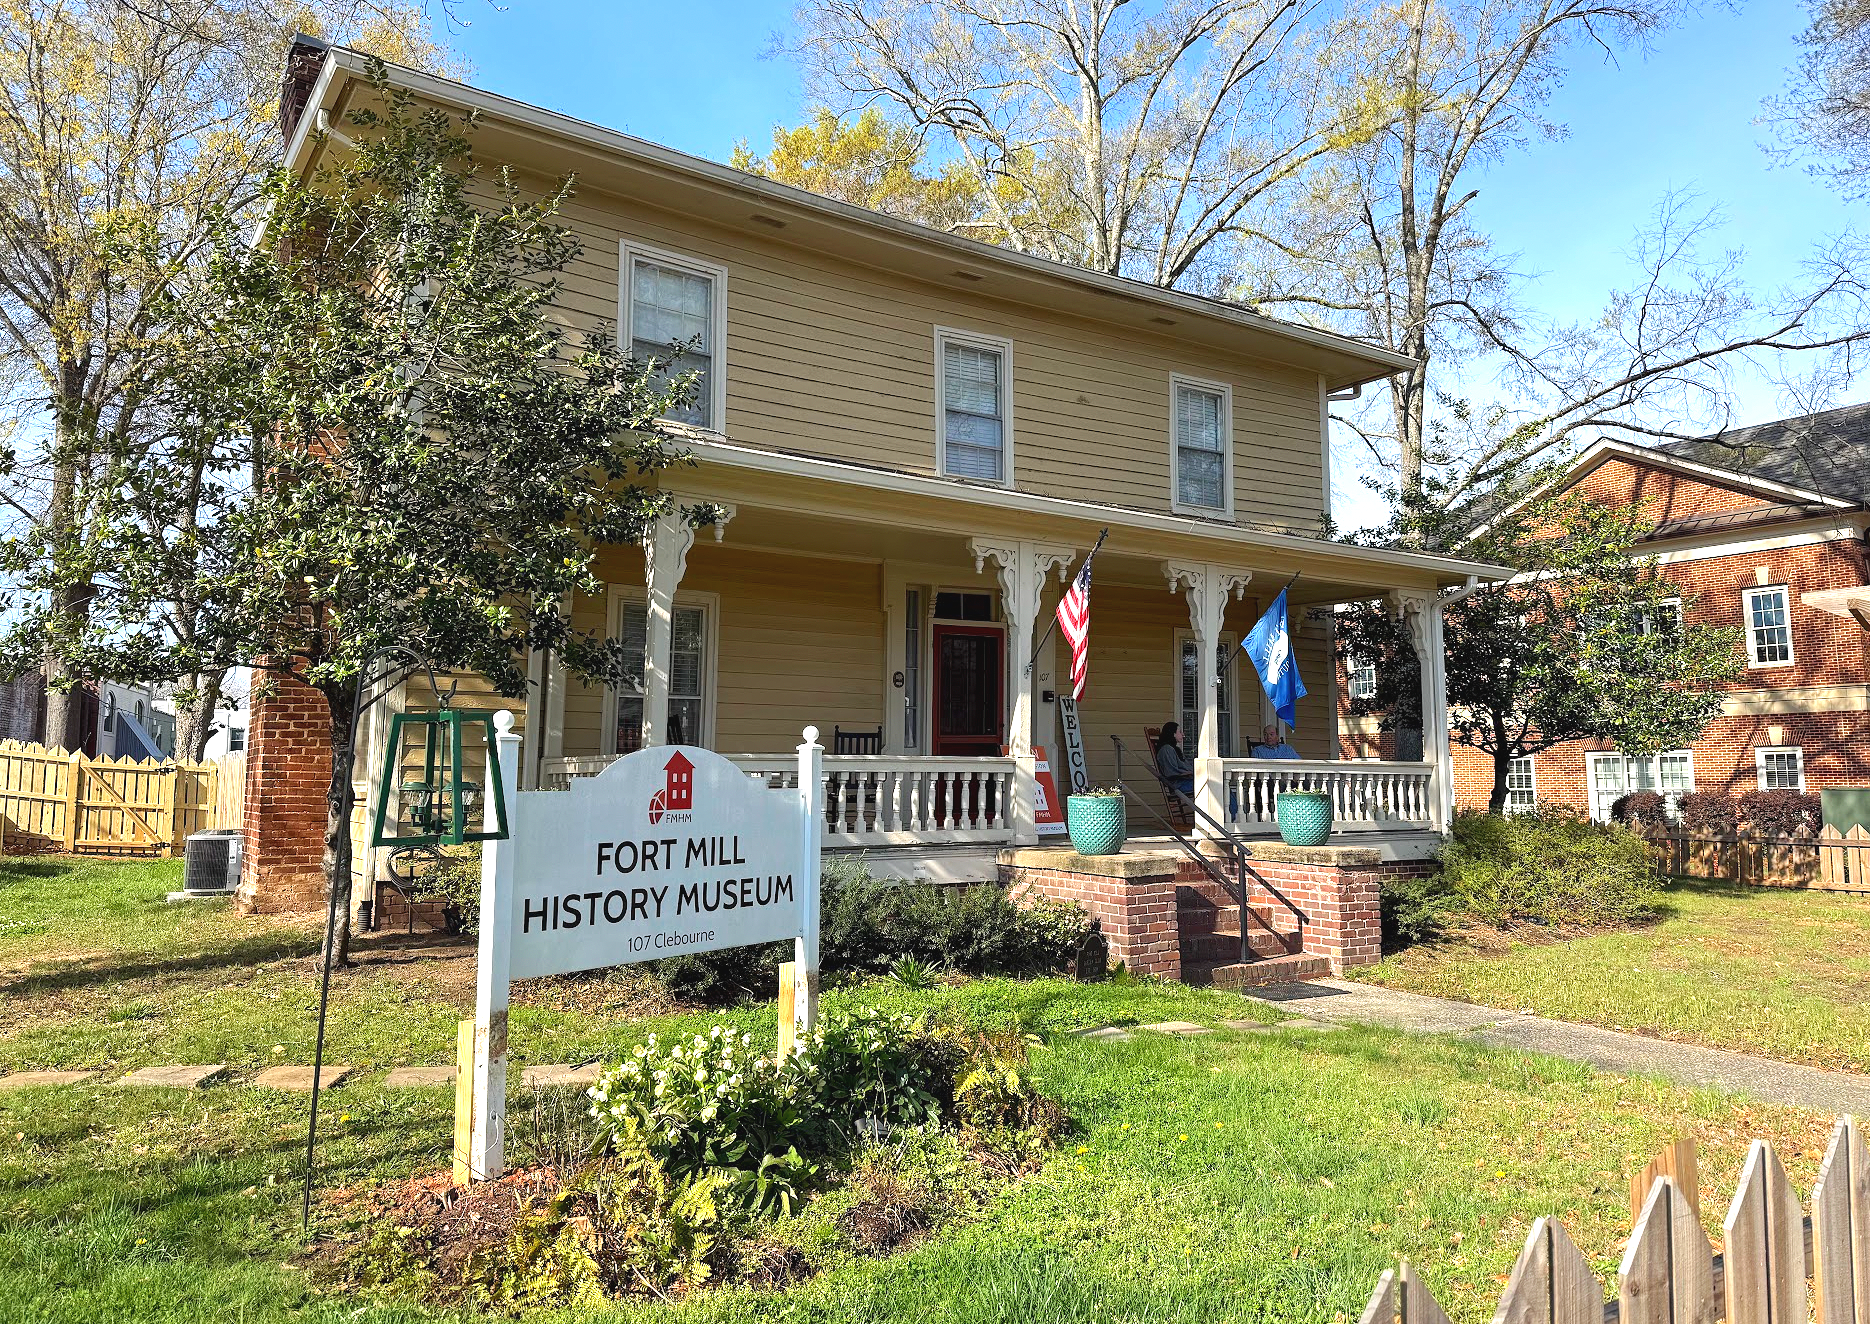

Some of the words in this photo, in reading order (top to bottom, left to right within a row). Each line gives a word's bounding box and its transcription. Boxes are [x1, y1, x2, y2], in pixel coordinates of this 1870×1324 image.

[1039, 672, 1050, 682] 107
[1063, 698, 1086, 789] WELCO
[666, 814, 692, 824] FMHM
[597, 839, 677, 875] FORT
[685, 836, 746, 867] MILL
[523, 886, 669, 933] HISTORY
[676, 875, 794, 915] MUSEUM
[627, 937, 651, 952] 107
[654, 930, 715, 949] Clebourne
